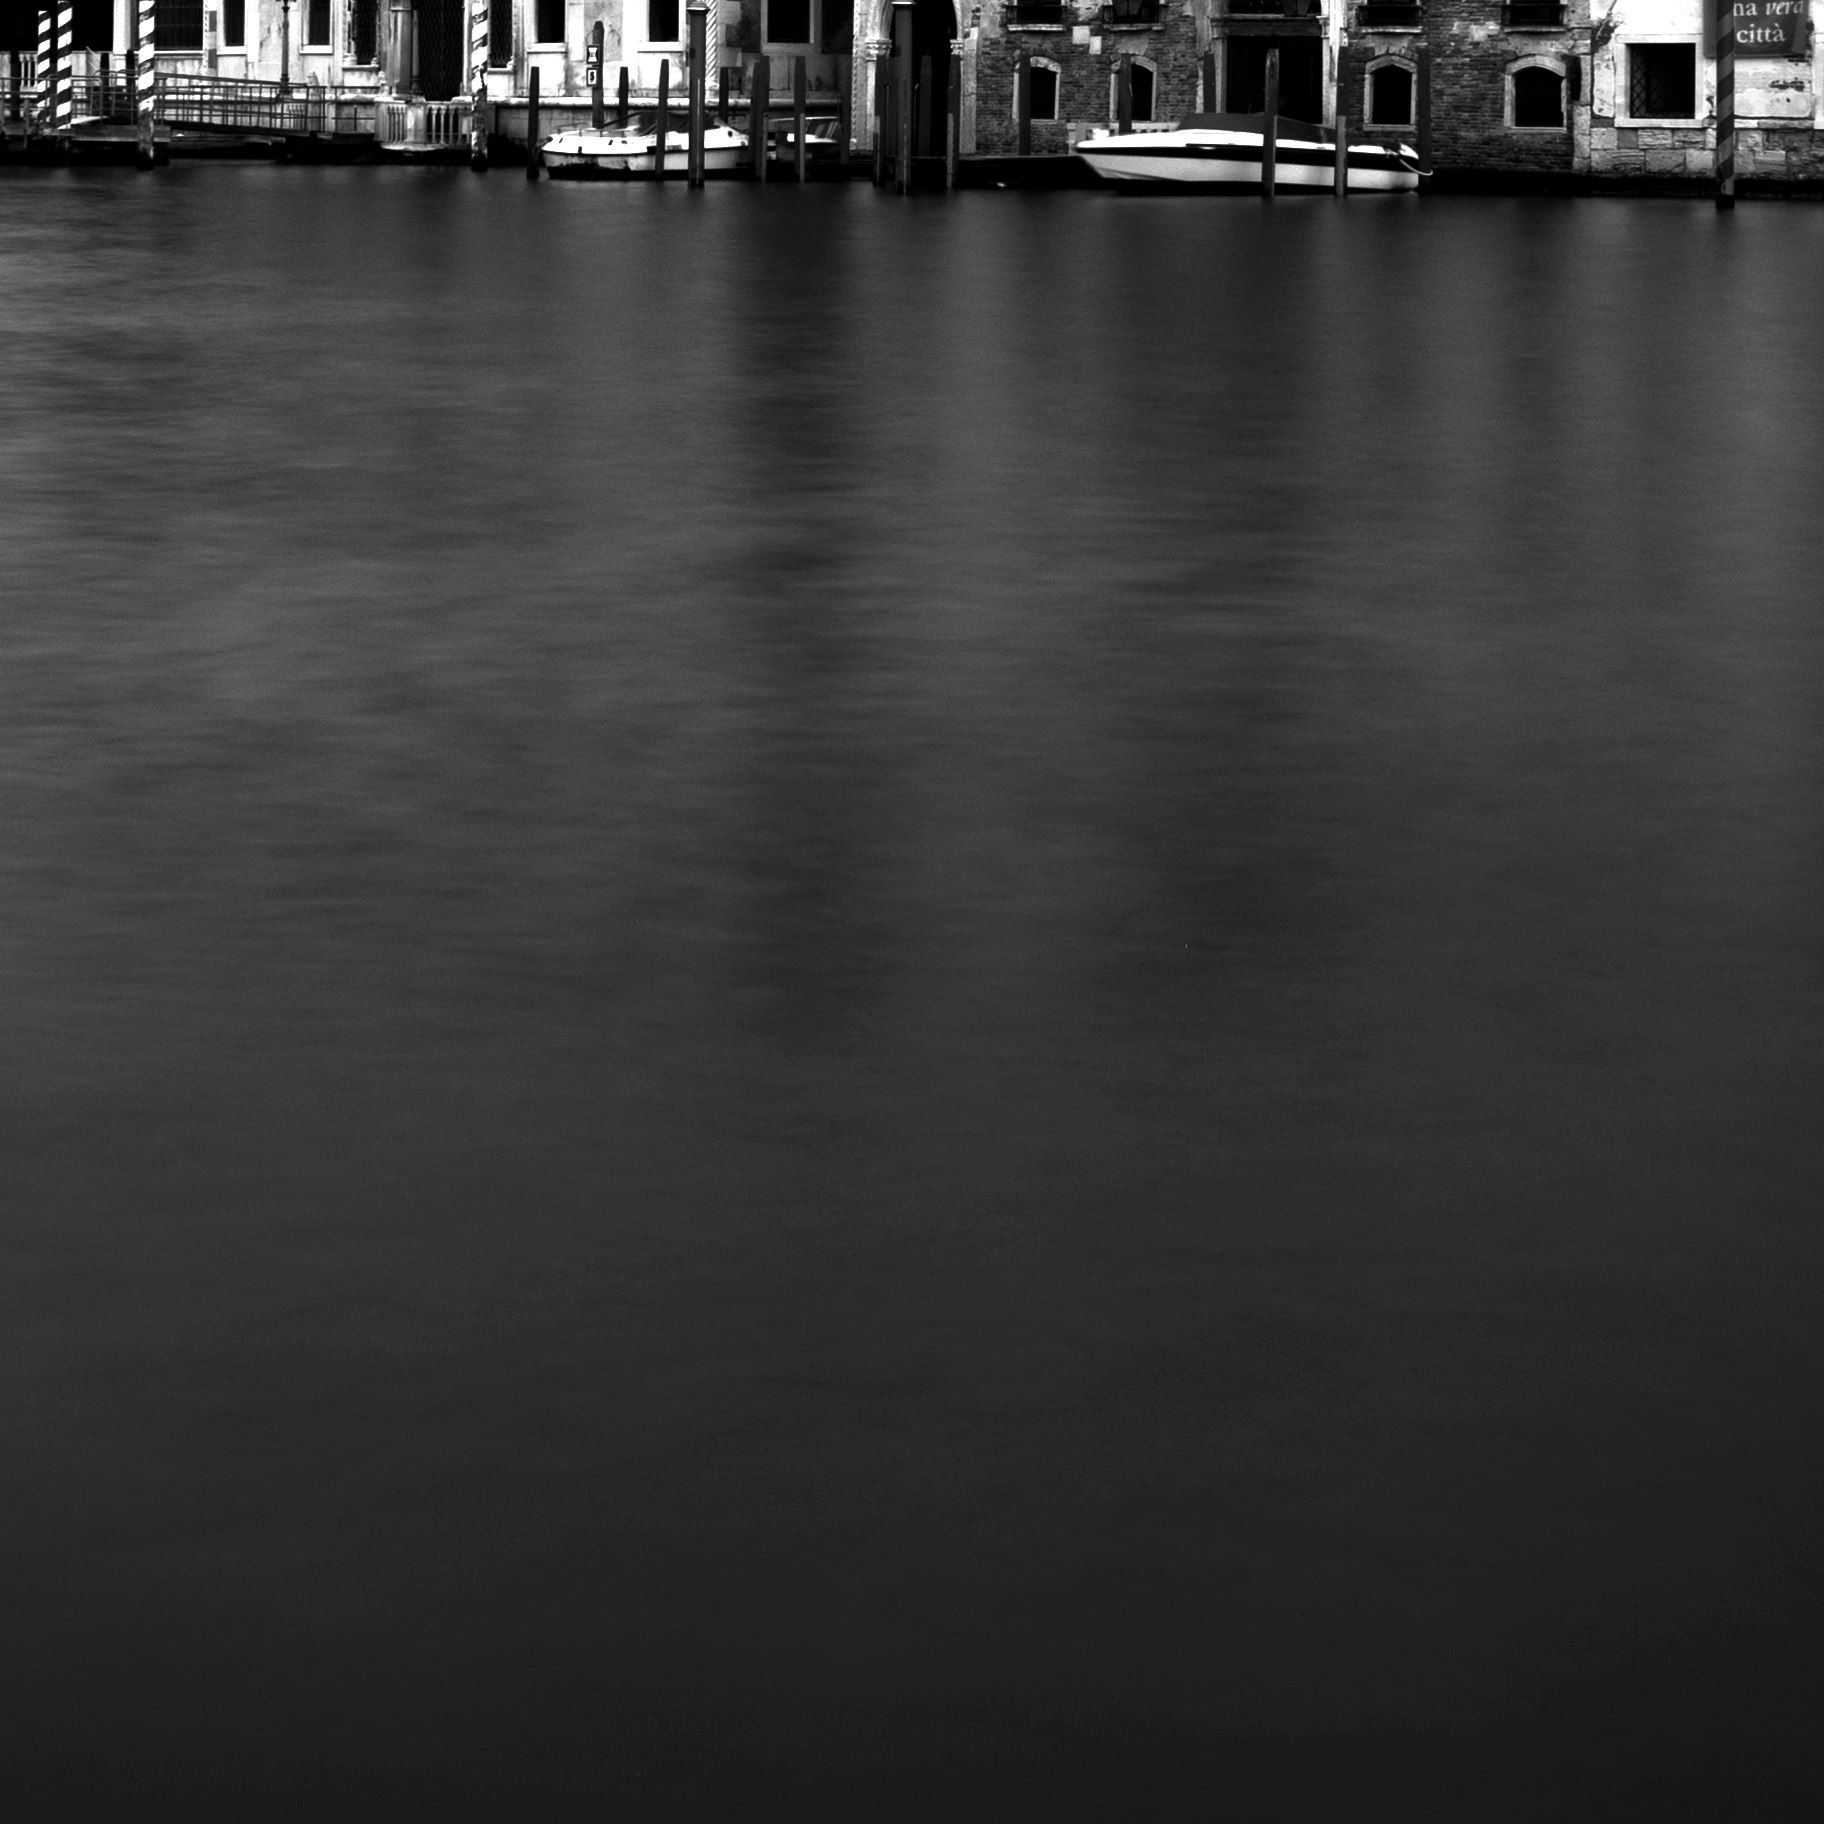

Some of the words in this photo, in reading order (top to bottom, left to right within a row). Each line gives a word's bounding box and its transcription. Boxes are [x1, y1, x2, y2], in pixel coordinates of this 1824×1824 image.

[1733, 3, 1757, 17] na
[1765, 0, 1804, 16] vera
[1736, 23, 1786, 44] città
